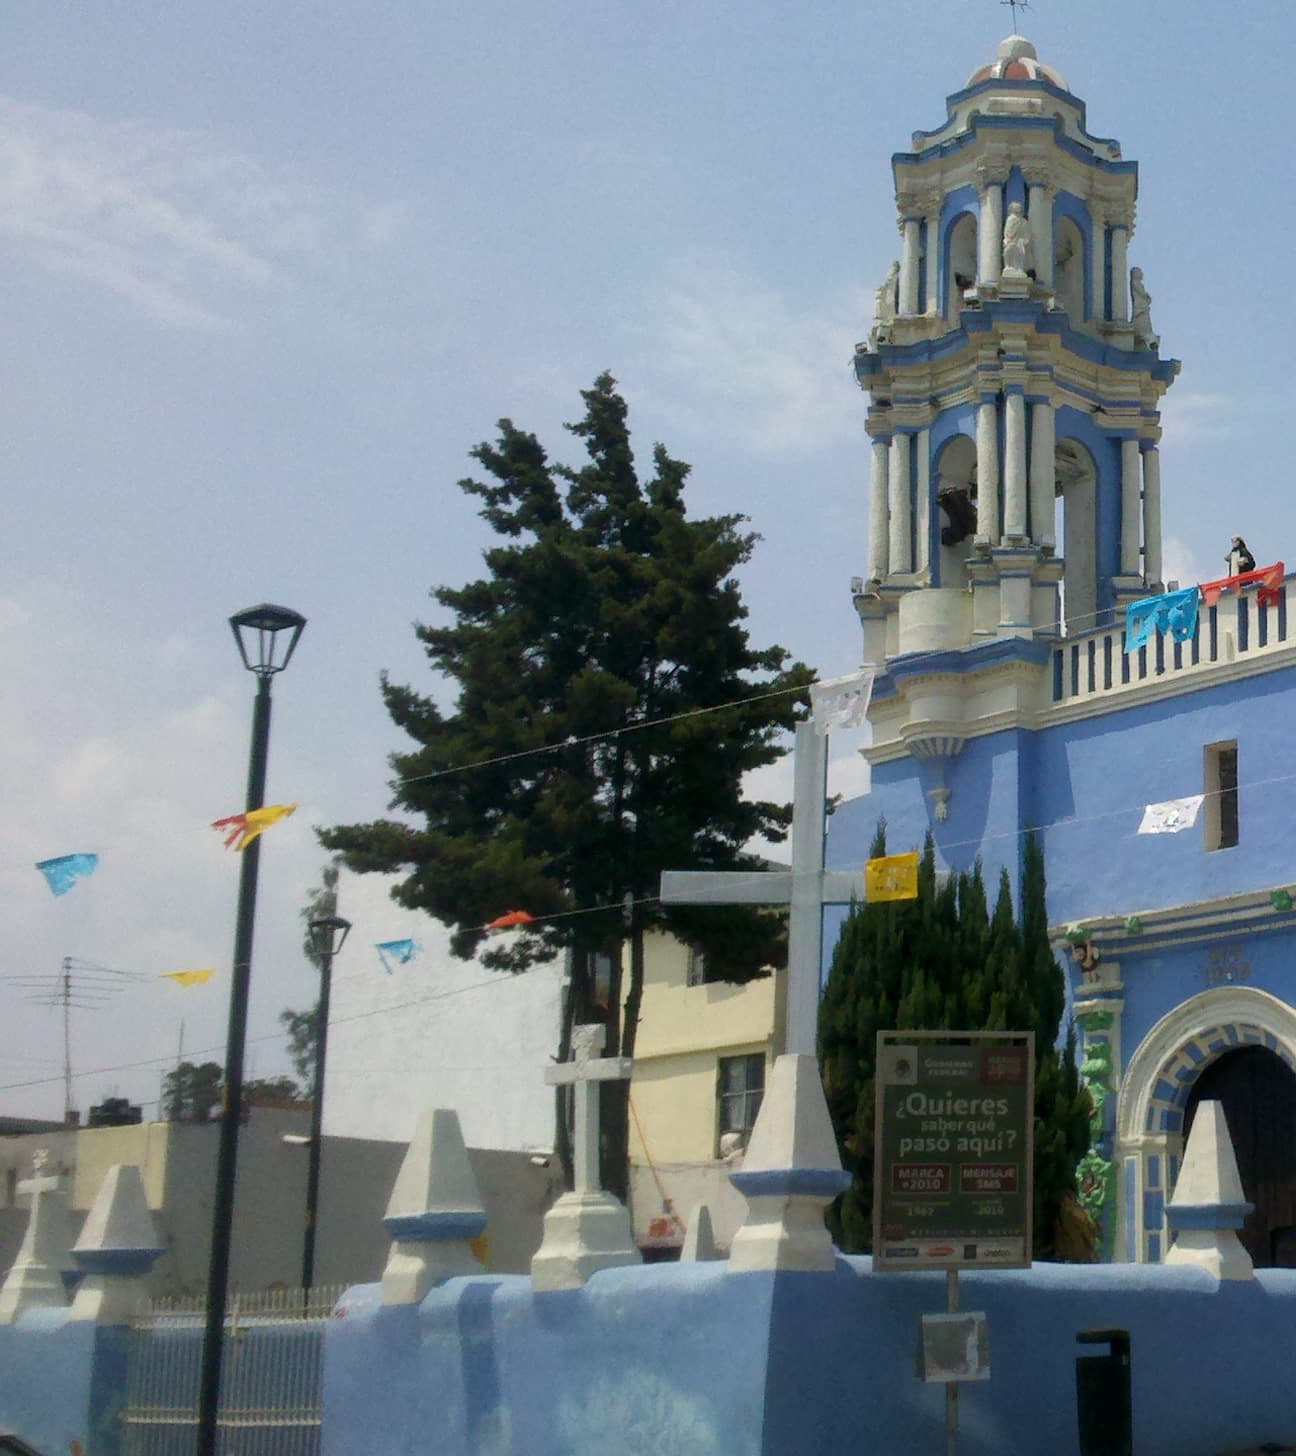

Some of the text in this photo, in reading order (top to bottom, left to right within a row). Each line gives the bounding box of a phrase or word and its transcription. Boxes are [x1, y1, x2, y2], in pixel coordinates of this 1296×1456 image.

[896, 1091, 1009, 1118] ¿Quieres
[921, 1116, 996, 1134] saber qué
[899, 1131, 950, 1158] pasó
[898, 1168, 944, 1179] MARCA
